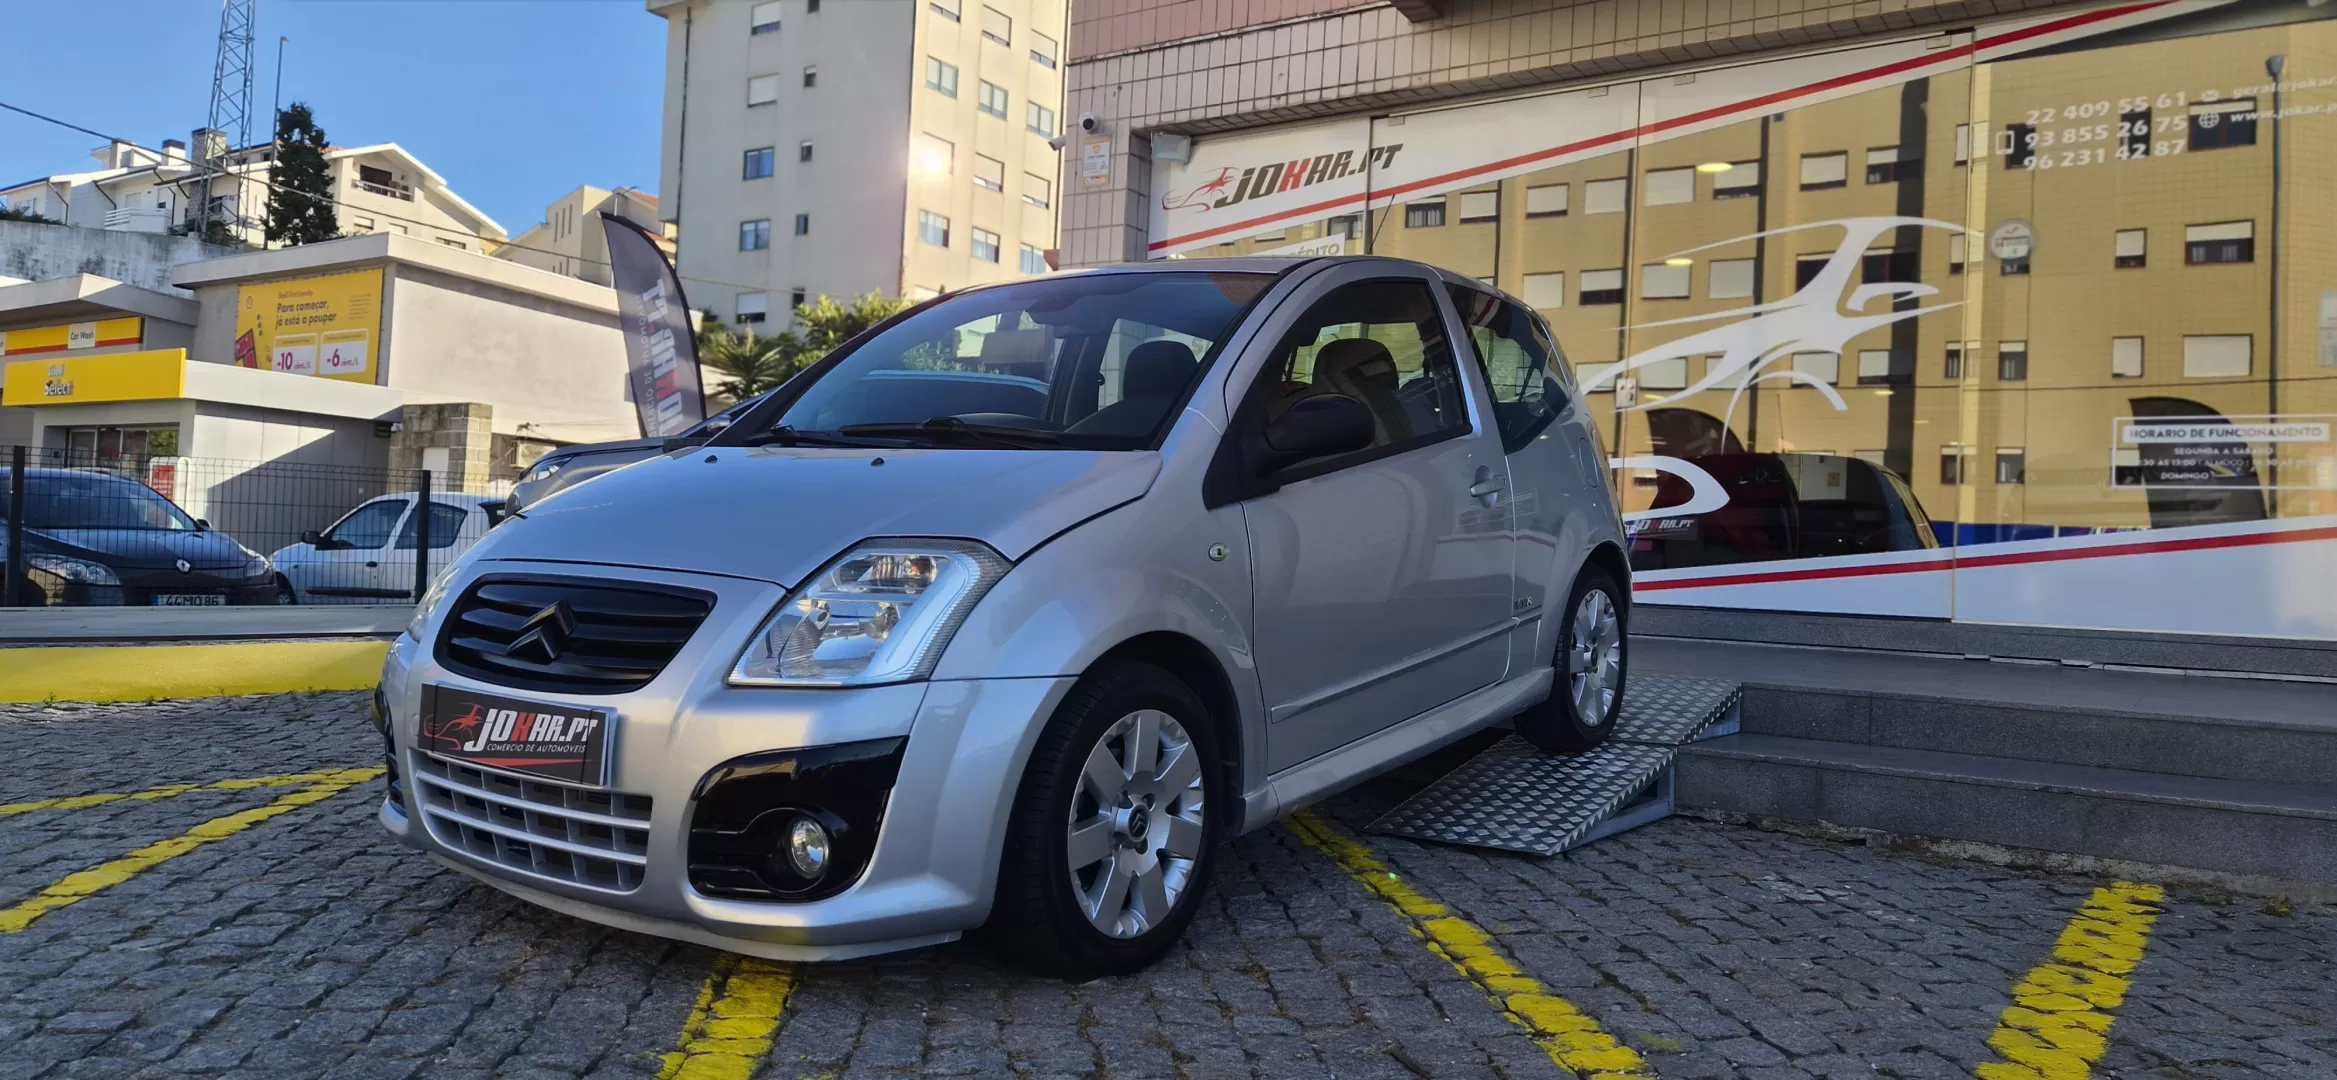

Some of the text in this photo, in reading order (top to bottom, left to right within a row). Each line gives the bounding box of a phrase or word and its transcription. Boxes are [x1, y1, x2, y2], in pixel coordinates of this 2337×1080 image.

[2025, 91, 2186, 125] 22 409 55 61
[2025, 115, 2187, 150] 93 855 26 75
[2023, 139, 2187, 171] 96 231 42 87
[1213, 143, 1403, 209] JOKAR.PT
[277, 302, 294, 313] Para
[308, 314, 337, 327] poupar
[70, 330, 94, 340] Car Wash
[2190, 428, 2205, 439] DE
[2208, 426, 2322, 439] FUNCIONAMENTO
[2174, 447, 2219, 456] SEGUNDA
[2160, 471, 2210, 481] DOMINGO
[463, 708, 599, 752] JOKAR.PT
[525, 743, 535, 752] DE
